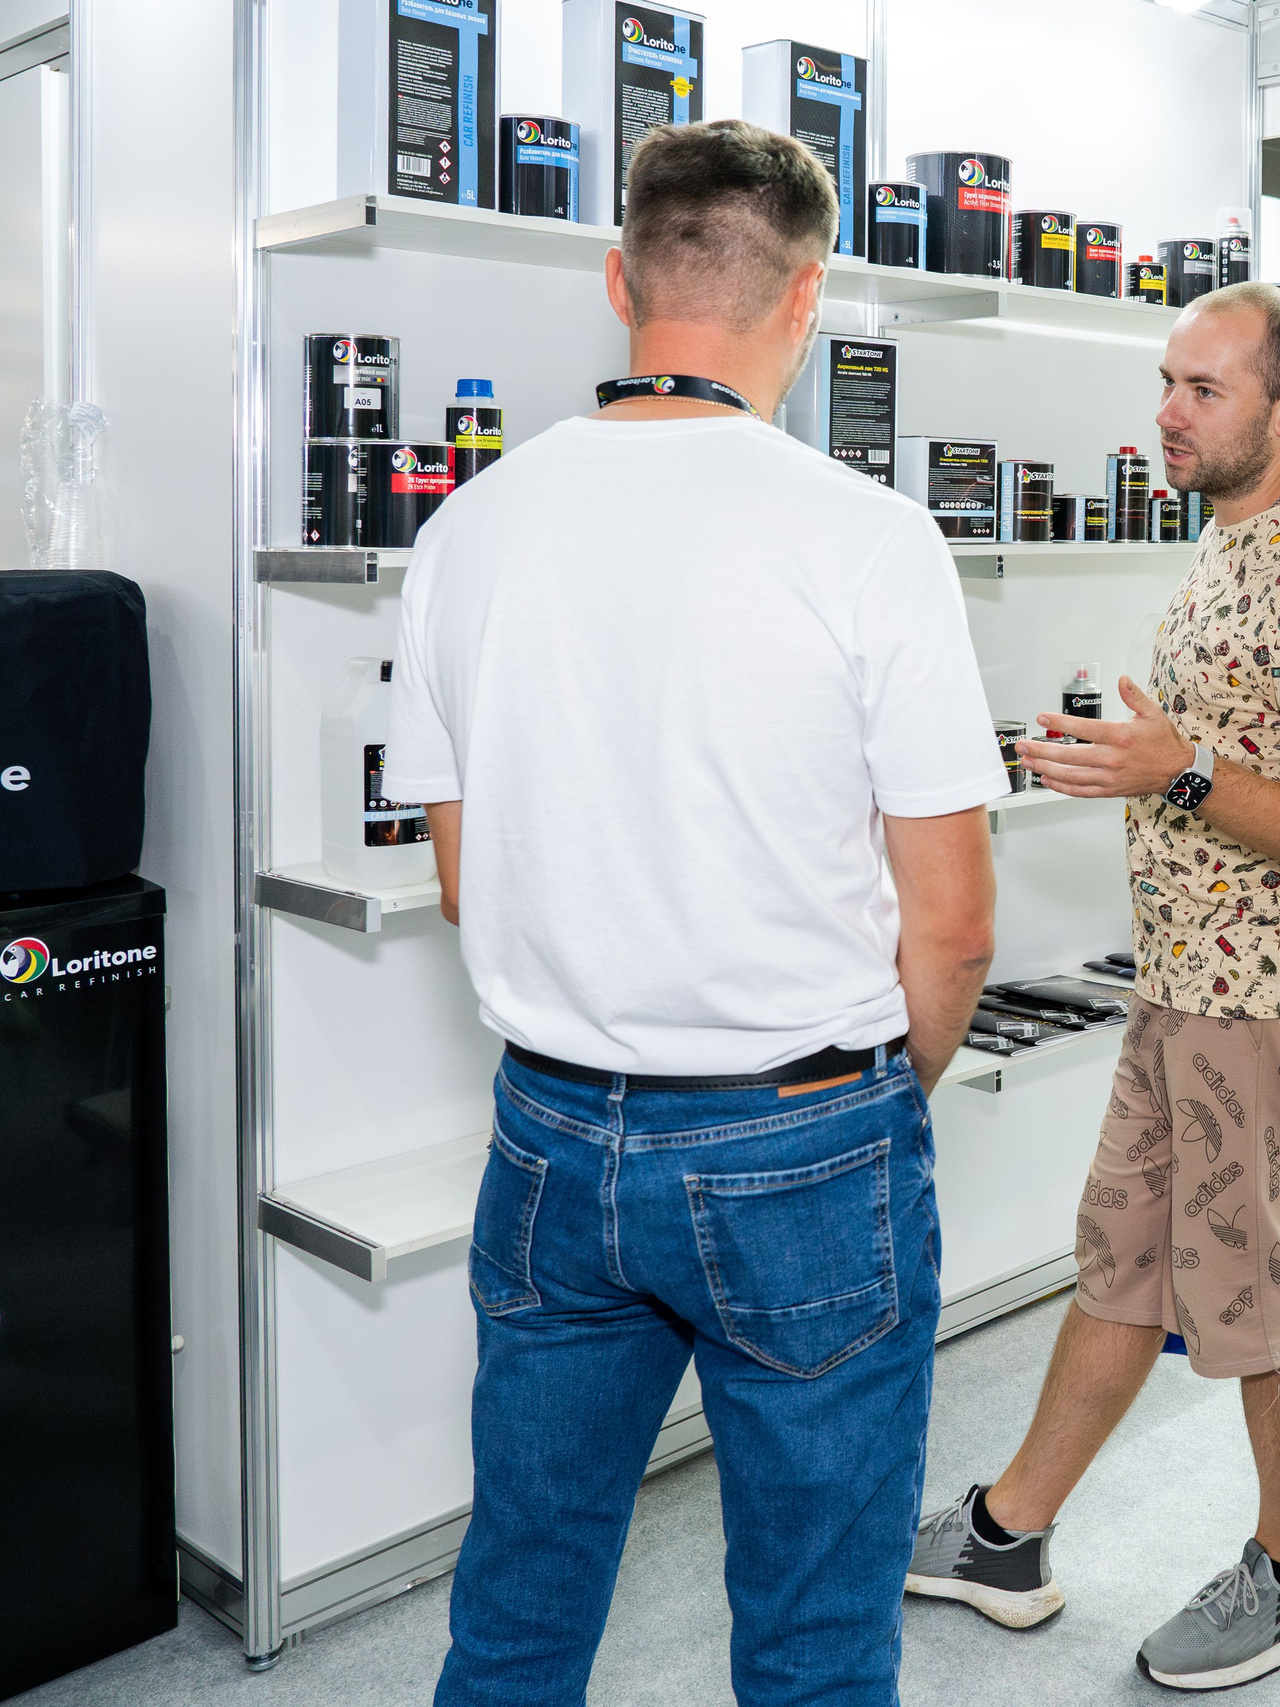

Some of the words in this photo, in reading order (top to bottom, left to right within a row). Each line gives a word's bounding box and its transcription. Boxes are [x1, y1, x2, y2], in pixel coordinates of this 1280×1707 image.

[627, 45, 658, 58] Очиститель
[658, 53, 683, 65] силикона
[643, 34, 686, 54] Loritone
[814, 71, 852, 88] Loritone
[463, 74, 474, 123] REFINISH
[463, 126, 474, 147] CAR
[842, 144, 850, 184] REFINISH
[616, 376, 656, 387] Loritone
[355, 398, 372, 406] A05
[415, 477, 429, 485] Грунт
[1190, 491, 1199, 516] REFIN
[370, 811, 387, 821] CAR
[387, 809, 419, 820] REFINISH
[51, 945, 157, 977] Loritone
[4, 987, 43, 1002] CAR
[59, 965, 156, 992] REFINISH
[1193, 1053, 1248, 1129] adidas
[1126, 1118, 1173, 1162] adid
[1184, 1161, 1244, 1218] adidas
